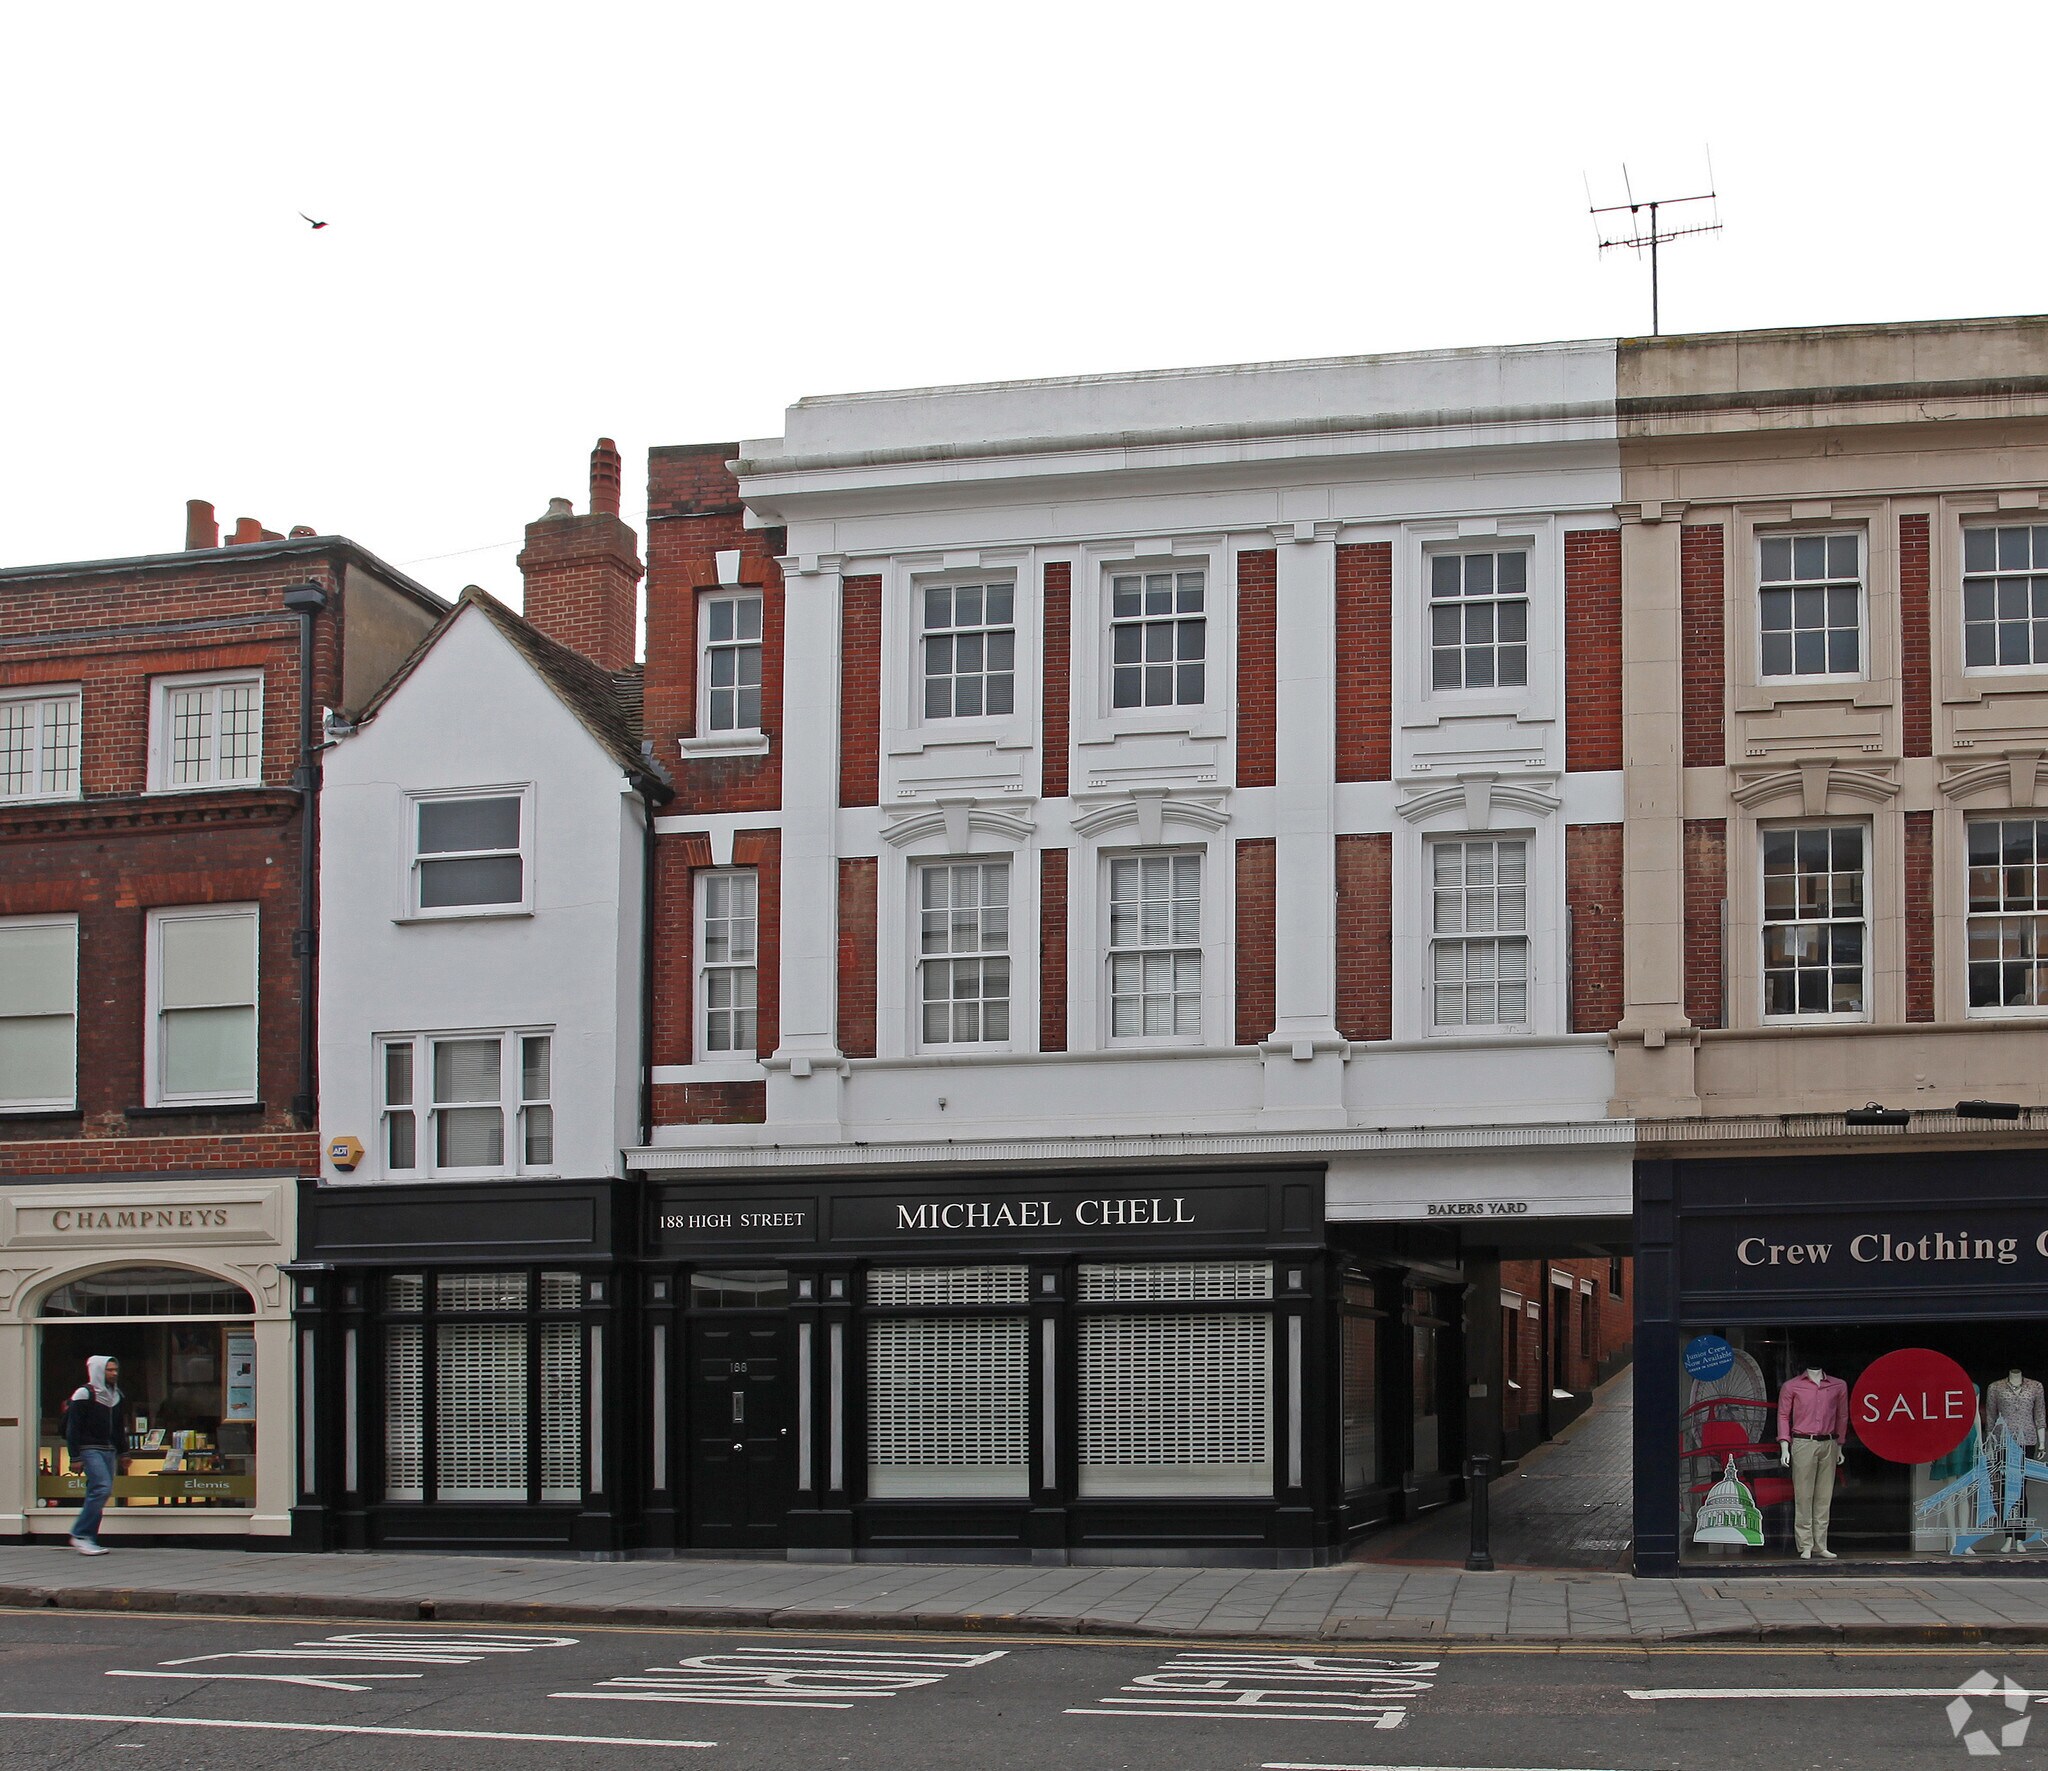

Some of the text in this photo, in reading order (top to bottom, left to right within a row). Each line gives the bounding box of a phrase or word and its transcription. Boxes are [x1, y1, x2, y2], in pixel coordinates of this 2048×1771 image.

[332, 1146, 348, 1156] ADT
[896, 1198, 1196, 1229] MICHAEL CHELL
[1427, 1202, 1528, 1215] BAKERS YARD
[52, 1209, 228, 1231] CHAMPNEYS
[659, 1212, 806, 1228] 188 HIGH STREET
[1737, 1237, 1833, 1266] Crew
[1850, 1231, 2018, 1264] Clothing
[1684, 1360, 1701, 1368] Now
[1702, 1351, 1732, 1363] Available
[1686, 1346, 1727, 1361] Junior Crew
[730, 1362, 748, 1373] 188
[1862, 1390, 1963, 1422] SALE
[184, 1478, 230, 1488] Elemis
[104, 1633, 580, 1691] ONLY
[547, 1647, 1010, 1709] TURN
[1061, 1653, 1440, 1729] RIGHT
